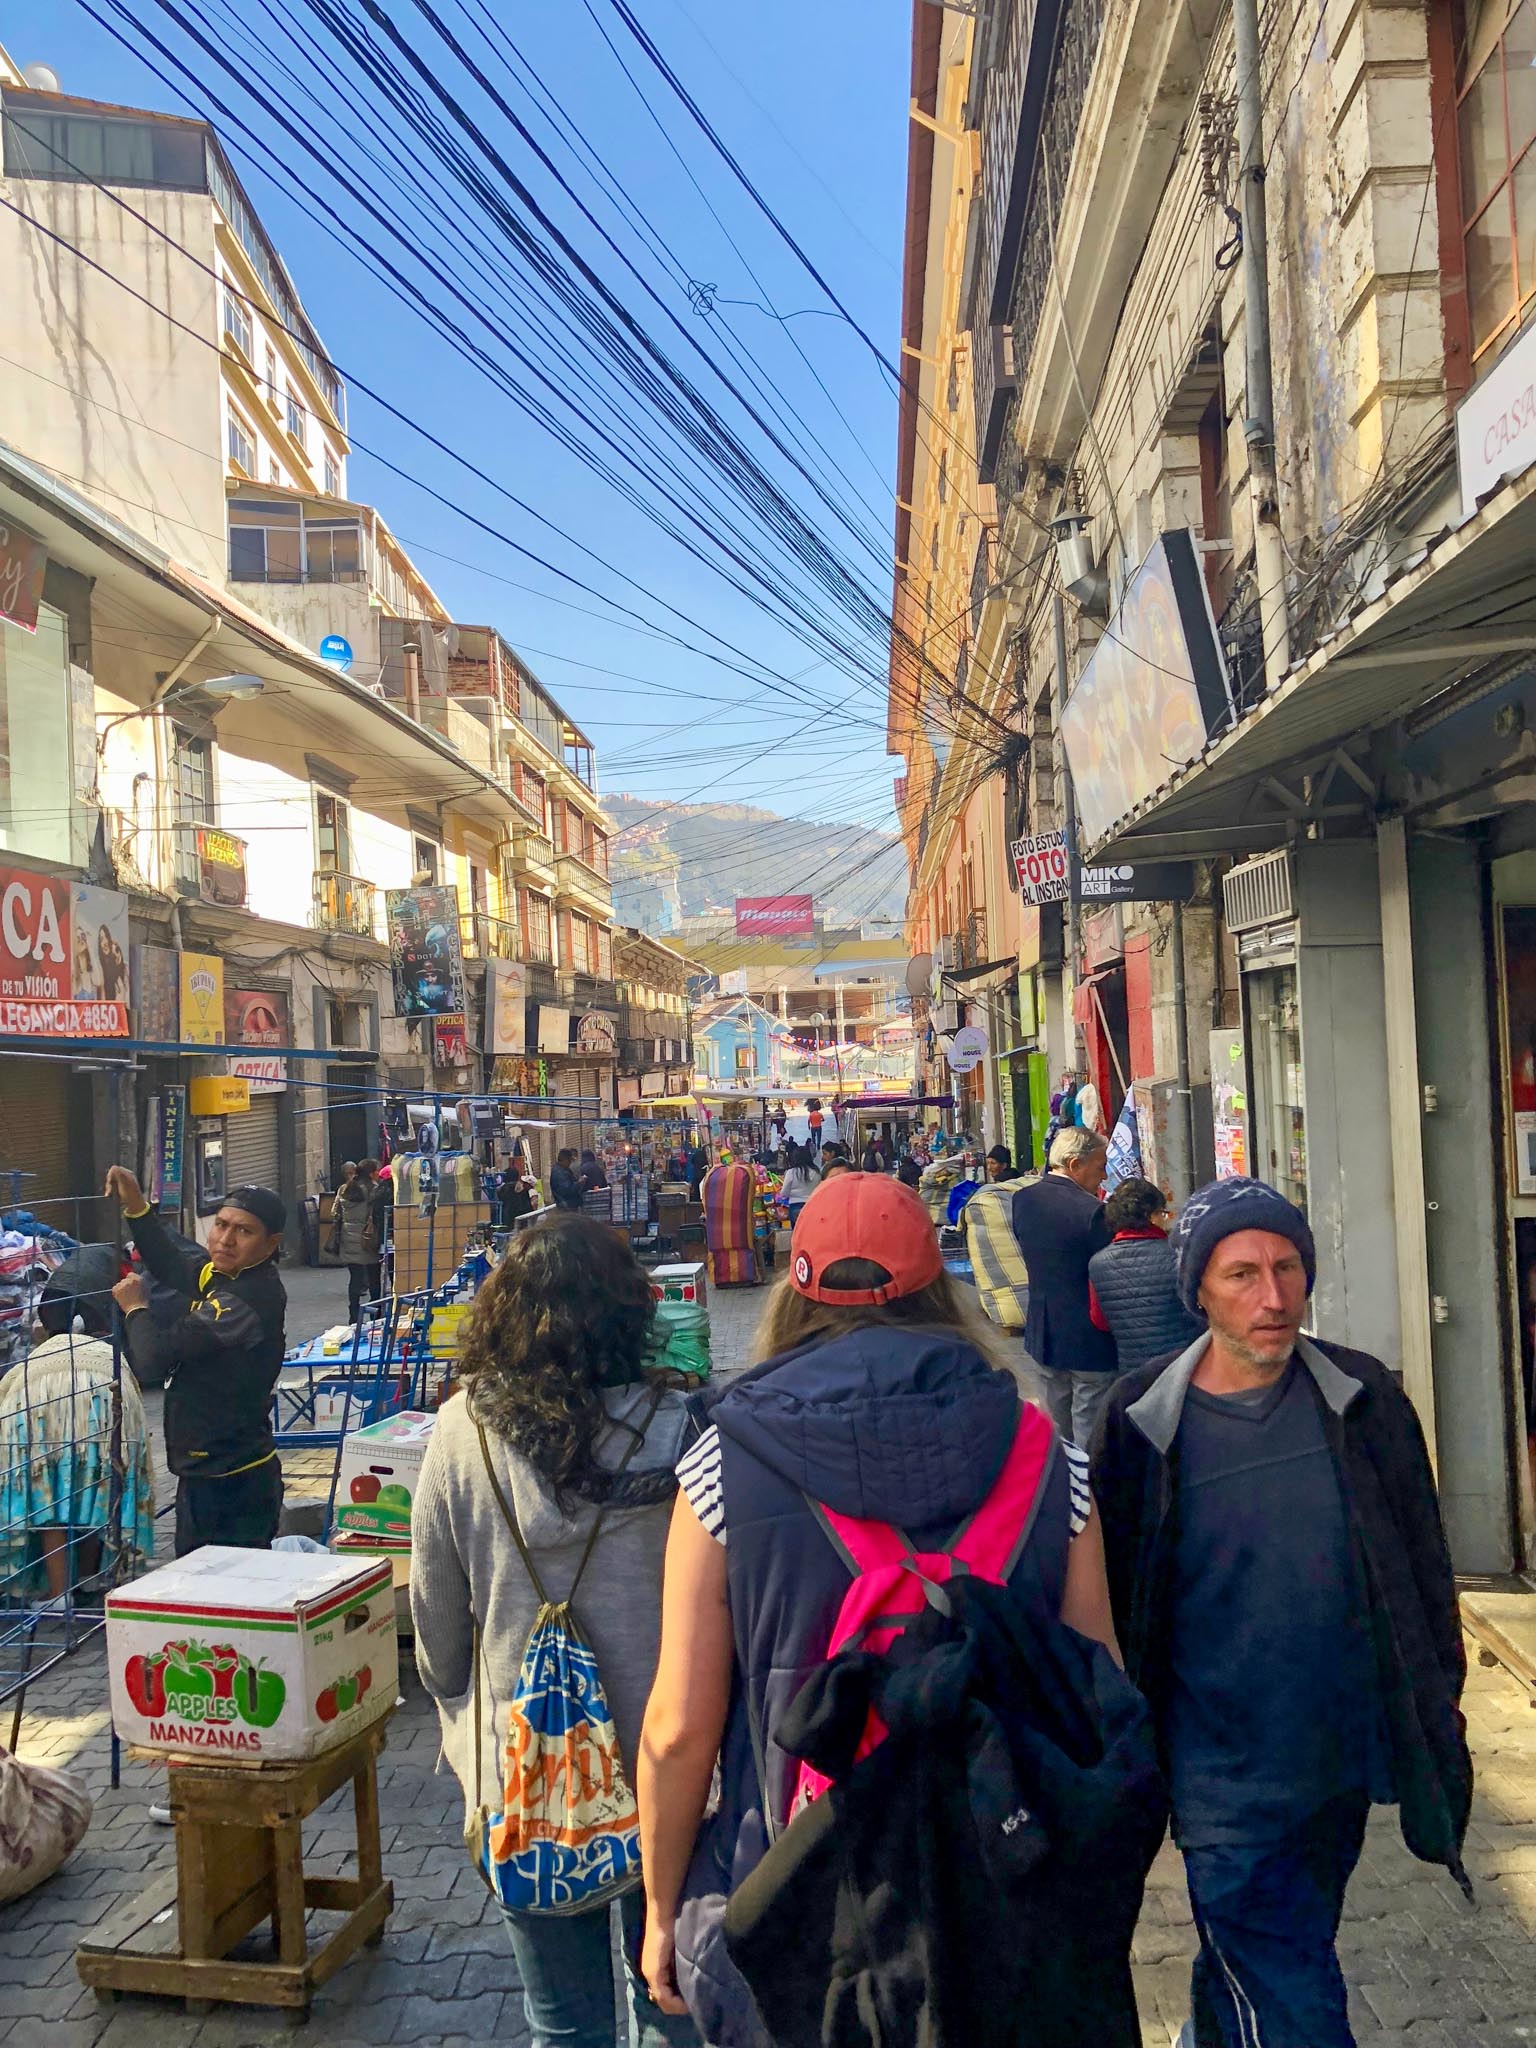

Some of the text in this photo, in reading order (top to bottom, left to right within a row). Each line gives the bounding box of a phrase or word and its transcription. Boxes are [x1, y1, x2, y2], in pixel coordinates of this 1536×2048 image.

[1012, 838, 1035, 858] FOTO
[1081, 865, 1134, 882] MIKO
[1022, 885, 1036, 906] AL
[1083, 882, 1135, 895] ART Gallery
[3, 979, 13, 994] DE
[15, 981, 24, 995] TU
[84, 1004, 117, 1031] #850
[436, 1015, 464, 1025] OPTICA
[164, 1096, 177, 1182] INTERNET
[798, 1261, 806, 1278] R
[166, 1691, 239, 1721] APPLES
[150, 1721, 262, 1752] MANZANAS
